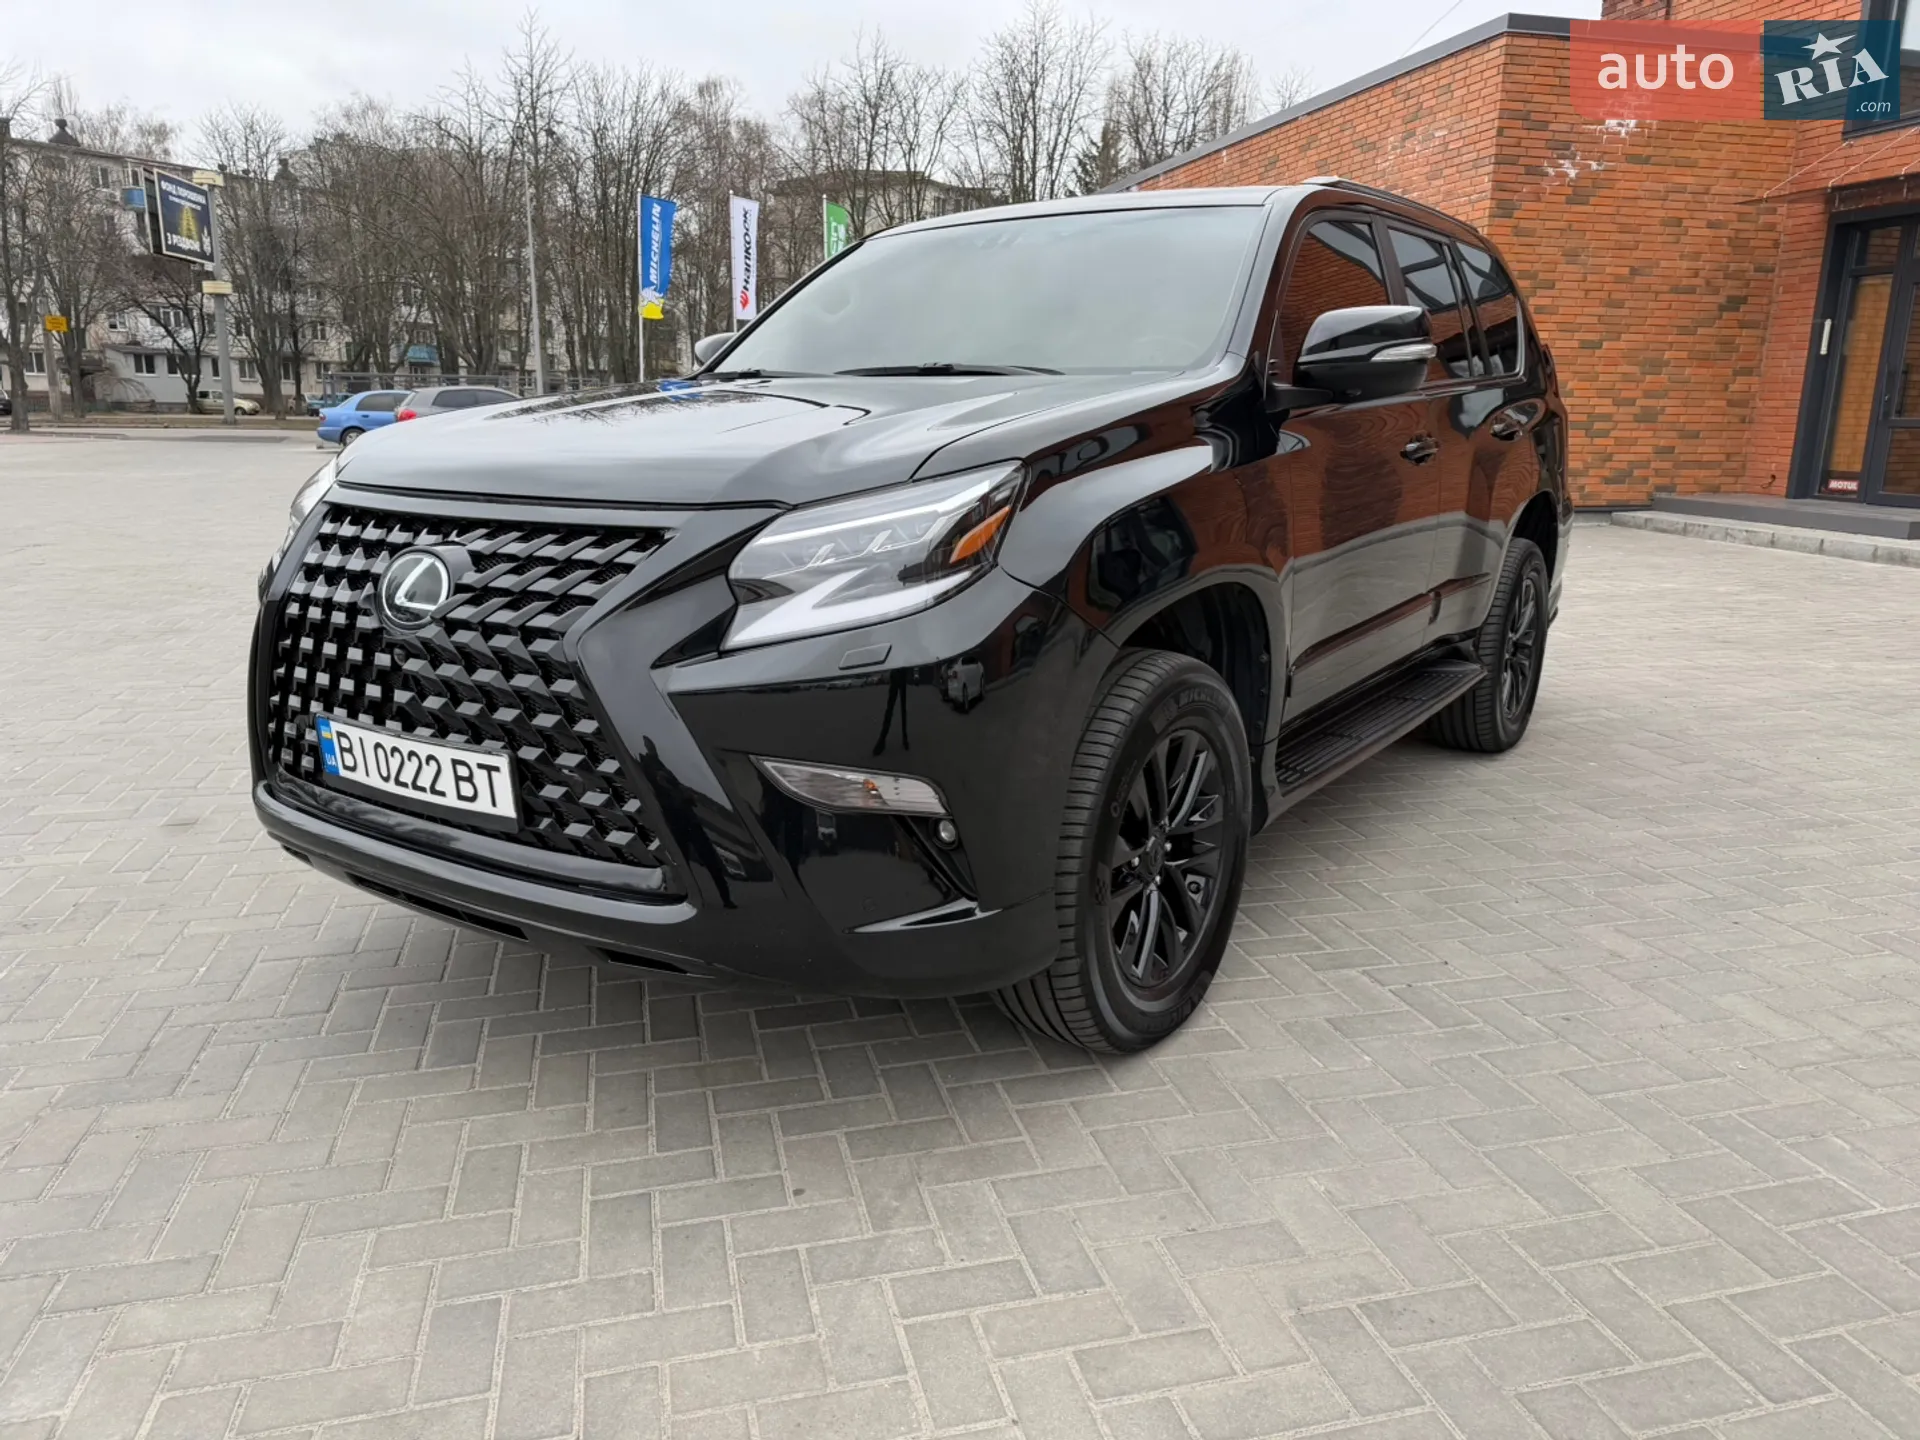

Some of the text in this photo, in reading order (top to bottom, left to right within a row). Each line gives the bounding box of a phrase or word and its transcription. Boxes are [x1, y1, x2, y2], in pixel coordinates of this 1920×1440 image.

[649, 202, 662, 284] MICHELIN
[1828, 480, 1858, 490] MOTUL
[325, 752, 337, 767] UA
[373, 741, 447, 798] 0222
[450, 757, 501, 808] BT
